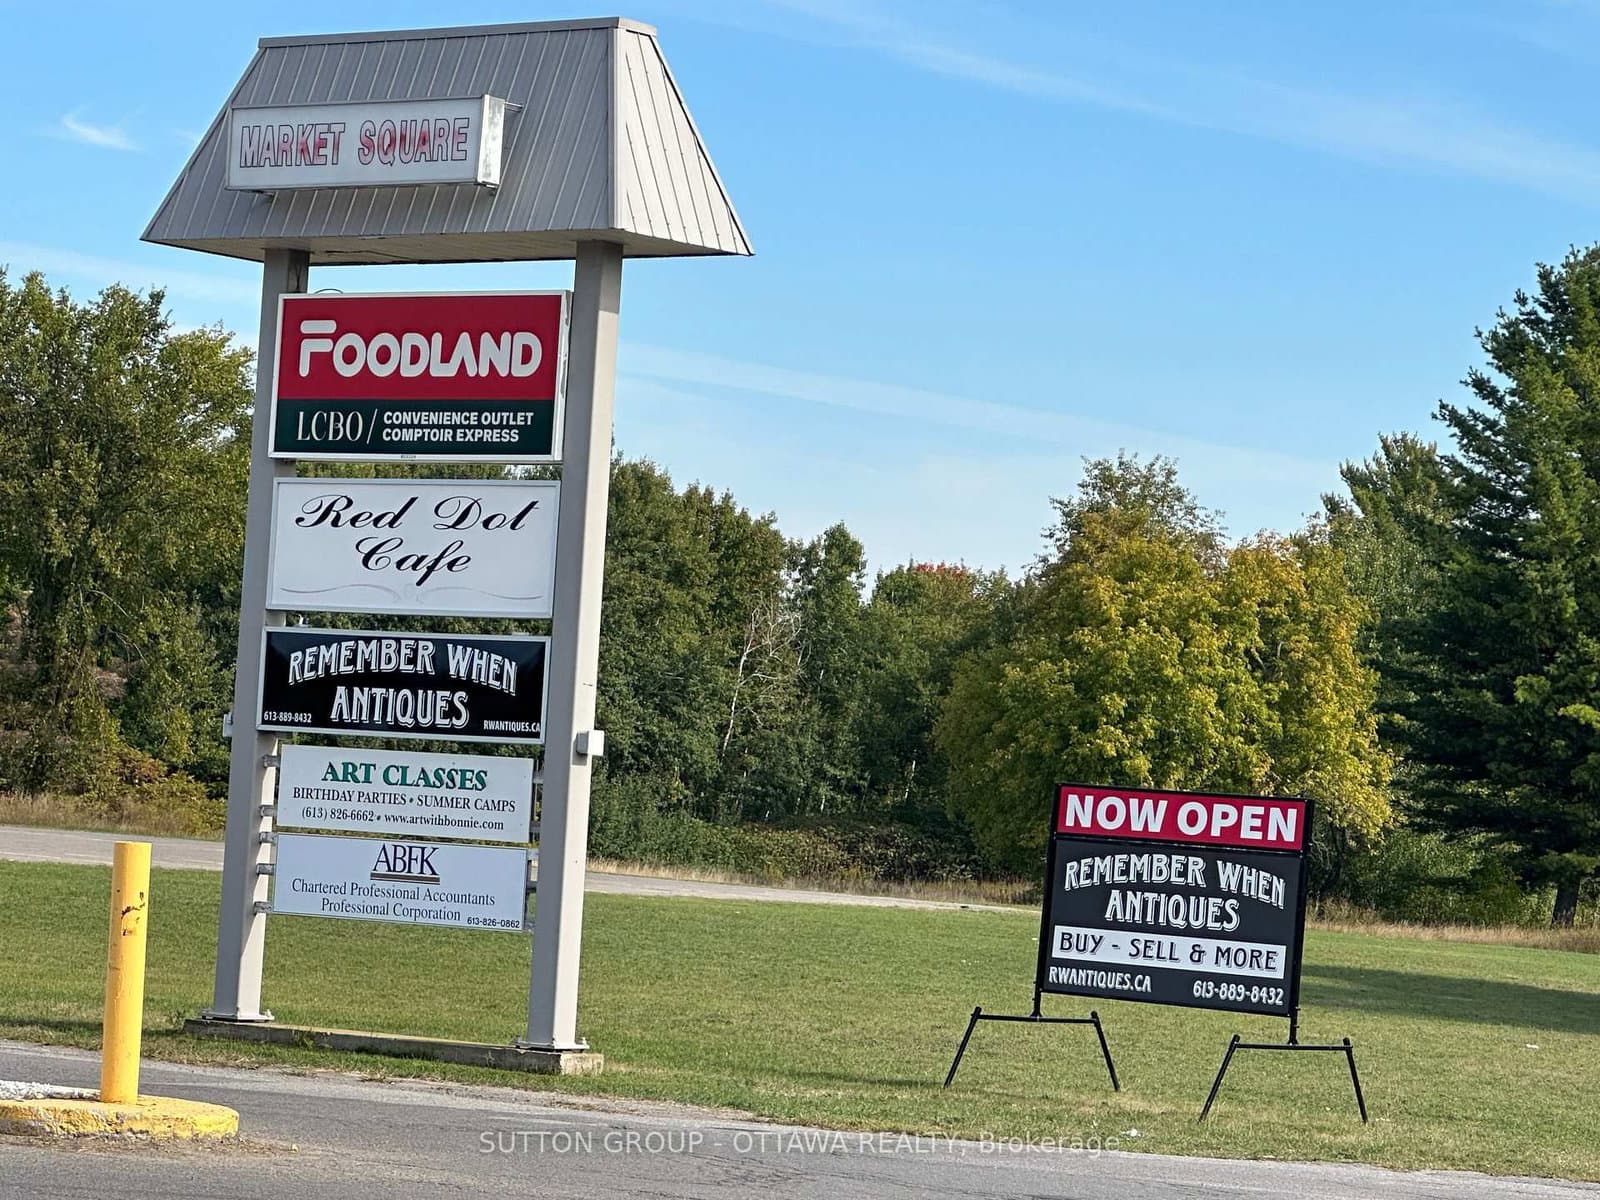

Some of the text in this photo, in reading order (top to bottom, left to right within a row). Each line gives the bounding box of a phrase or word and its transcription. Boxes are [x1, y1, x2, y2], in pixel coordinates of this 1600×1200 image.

[240, 117, 470, 168] MARKET SQUARE
[299, 319, 543, 377] FOODLAND
[383, 411, 534, 426] CONVENIENCE OUTLET
[382, 428, 519, 442] COMPTOIR EXPRESS
[295, 494, 540, 531] Red Dot
[355, 536, 472, 587] Cafe
[288, 639, 518, 696] REMEMBER WHEN
[263, 711, 312, 723] 613-889-8432
[330, 686, 470, 728] ANTIQUES
[483, 720, 541, 732] RWANTIQUES.CA
[321, 761, 488, 791] ART CLASSES
[293, 787, 516, 813] BIRTHDAY PARTIES SUMMER CAMPS
[302, 806, 504, 831] (613) 826-6662 www.artwithbonnie.com
[1065, 794, 1298, 842] NOW OPEN
[292, 878, 496, 906] Chartered Professional Accountants
[1064, 853, 1285, 909] REMEMBER WHEN
[321, 898, 461, 922] Professional Corporation
[467, 916, 520, 929] 613-826-0862
[1104, 889, 1240, 932] ANTIQUES
[1059, 932, 1104, 954] BUY
[1128, 938, 1180, 964] SELL
[1189, 943, 1206, 965] &
[1214, 945, 1278, 971] MORE
[1049, 966, 1152, 993] RWANTIQUES.CA
[1193, 980, 1284, 1006] 613-889-8432
